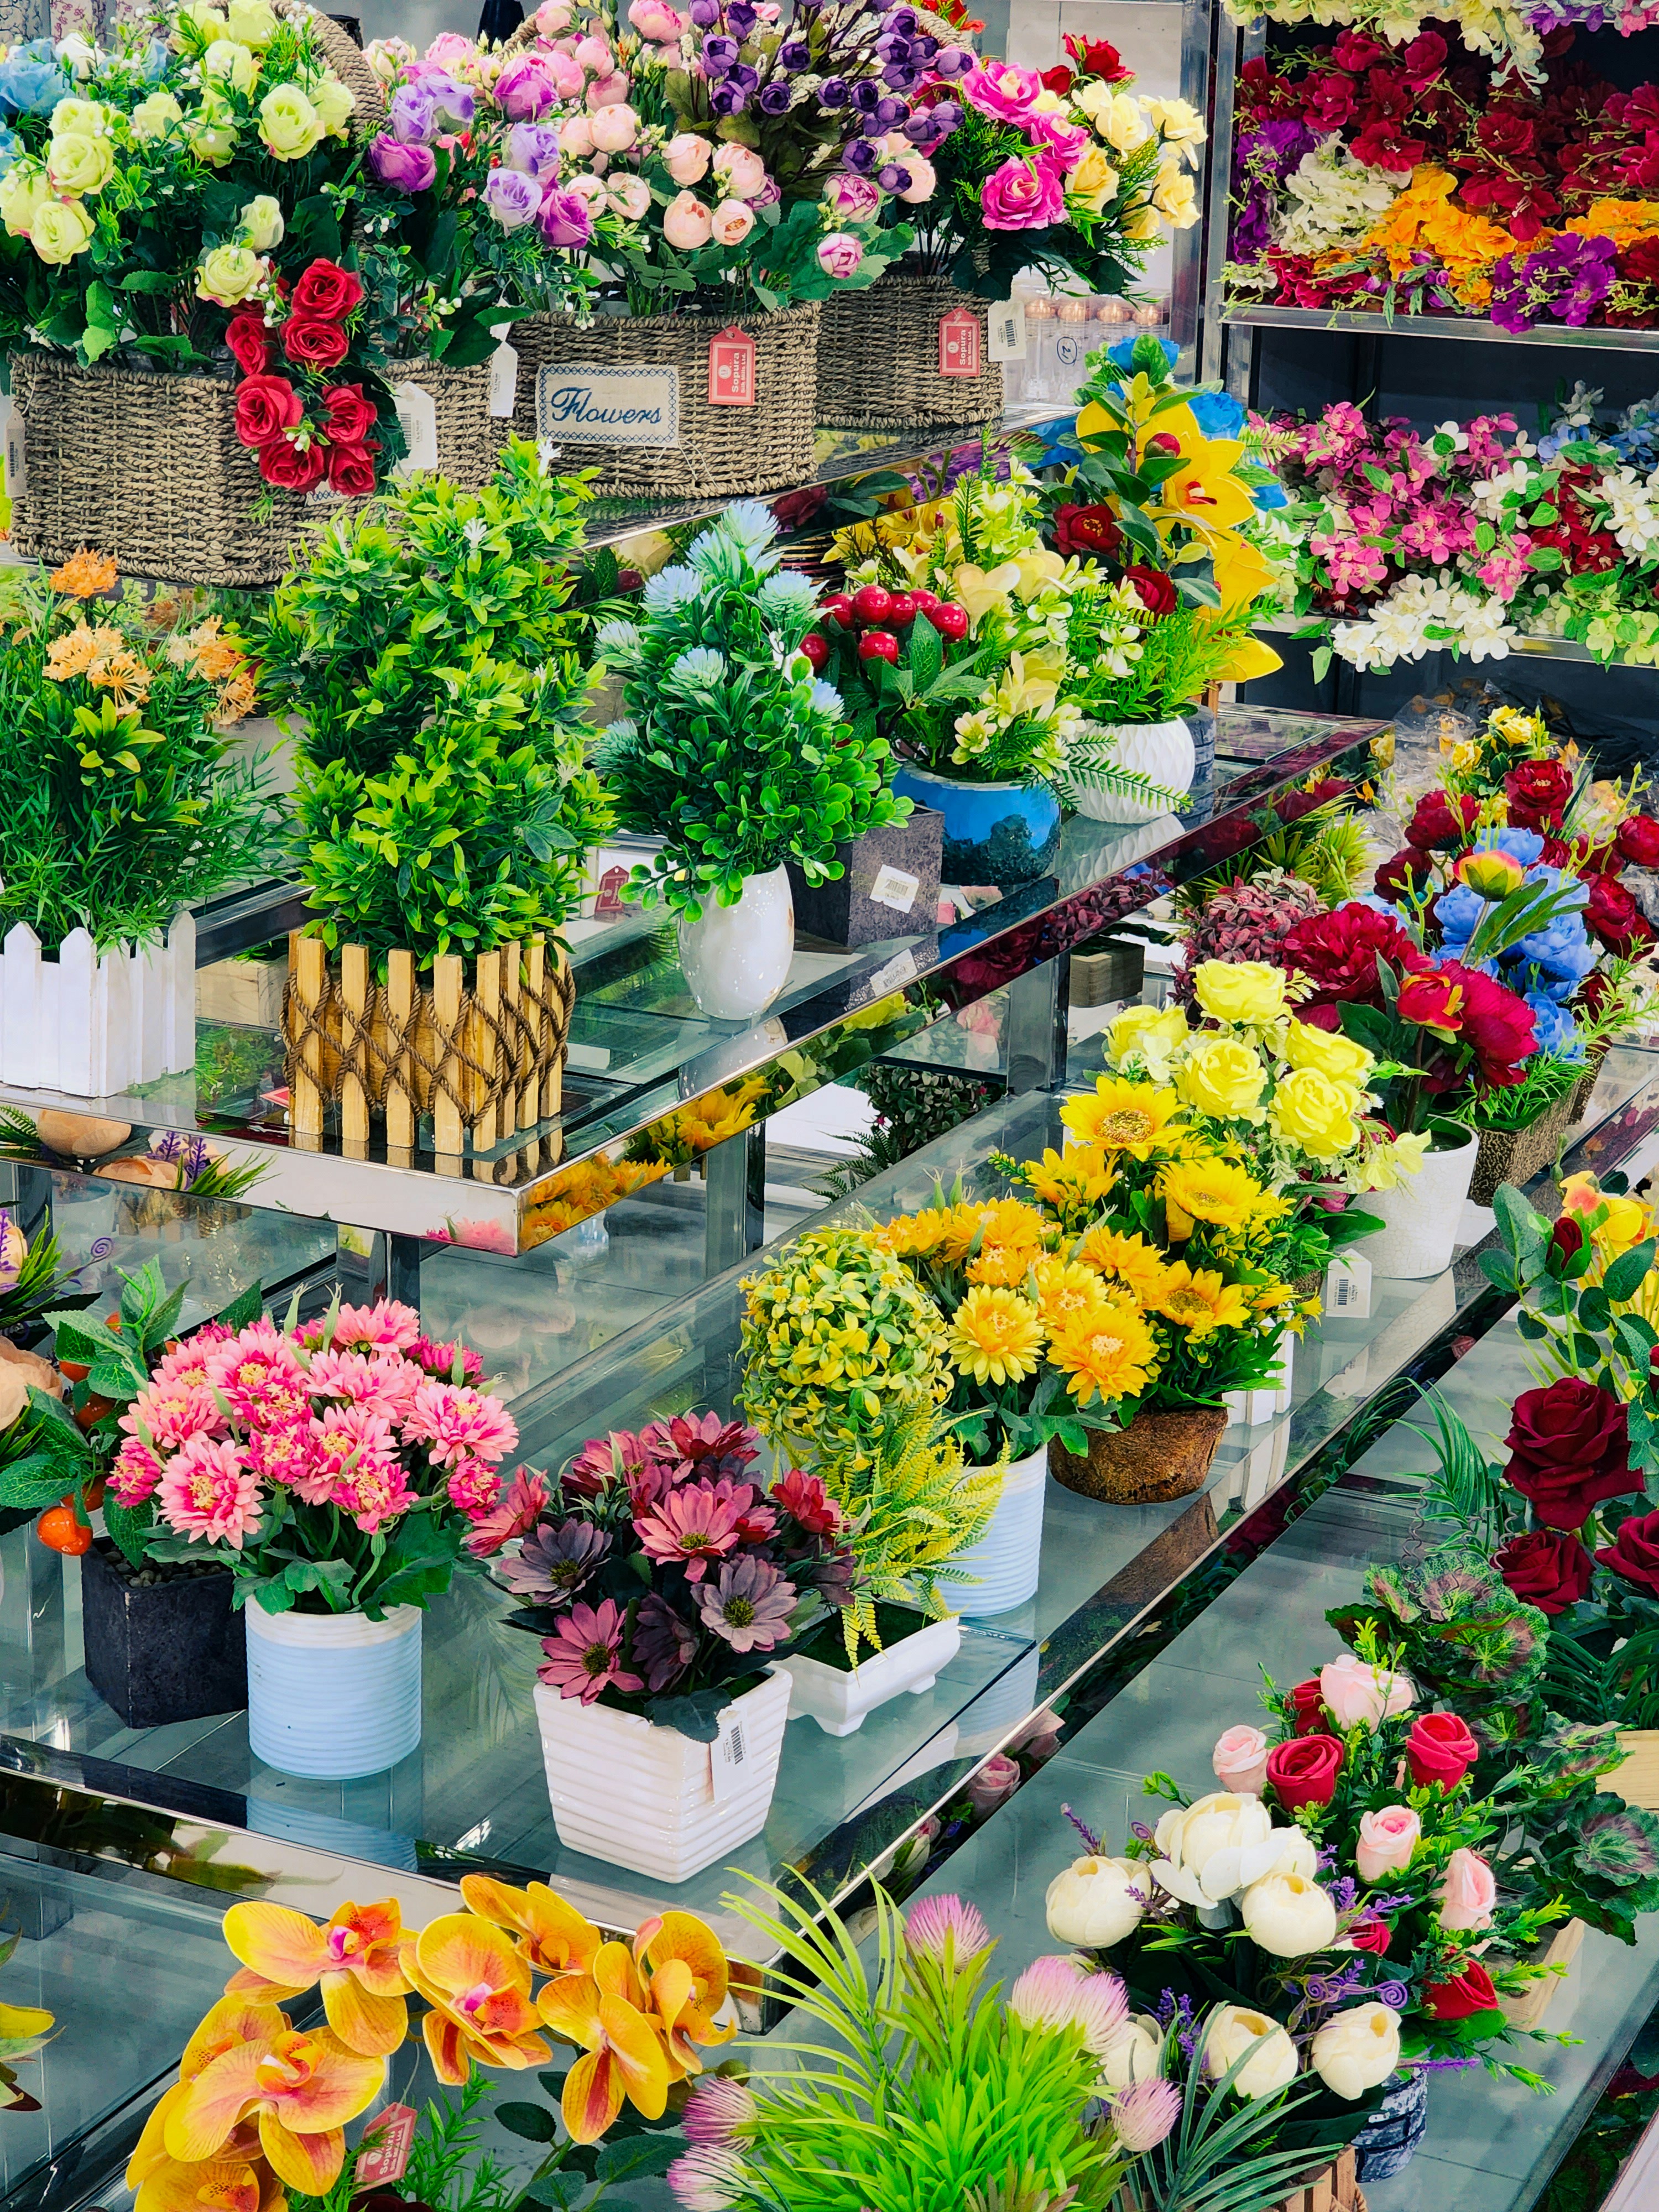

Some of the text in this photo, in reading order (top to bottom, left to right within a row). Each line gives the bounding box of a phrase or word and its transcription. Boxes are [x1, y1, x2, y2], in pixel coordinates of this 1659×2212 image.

[732, 352, 740, 393] Sopura
[551, 387, 662, 424] Flowers
[379, 2131, 396, 2175] Sopura
